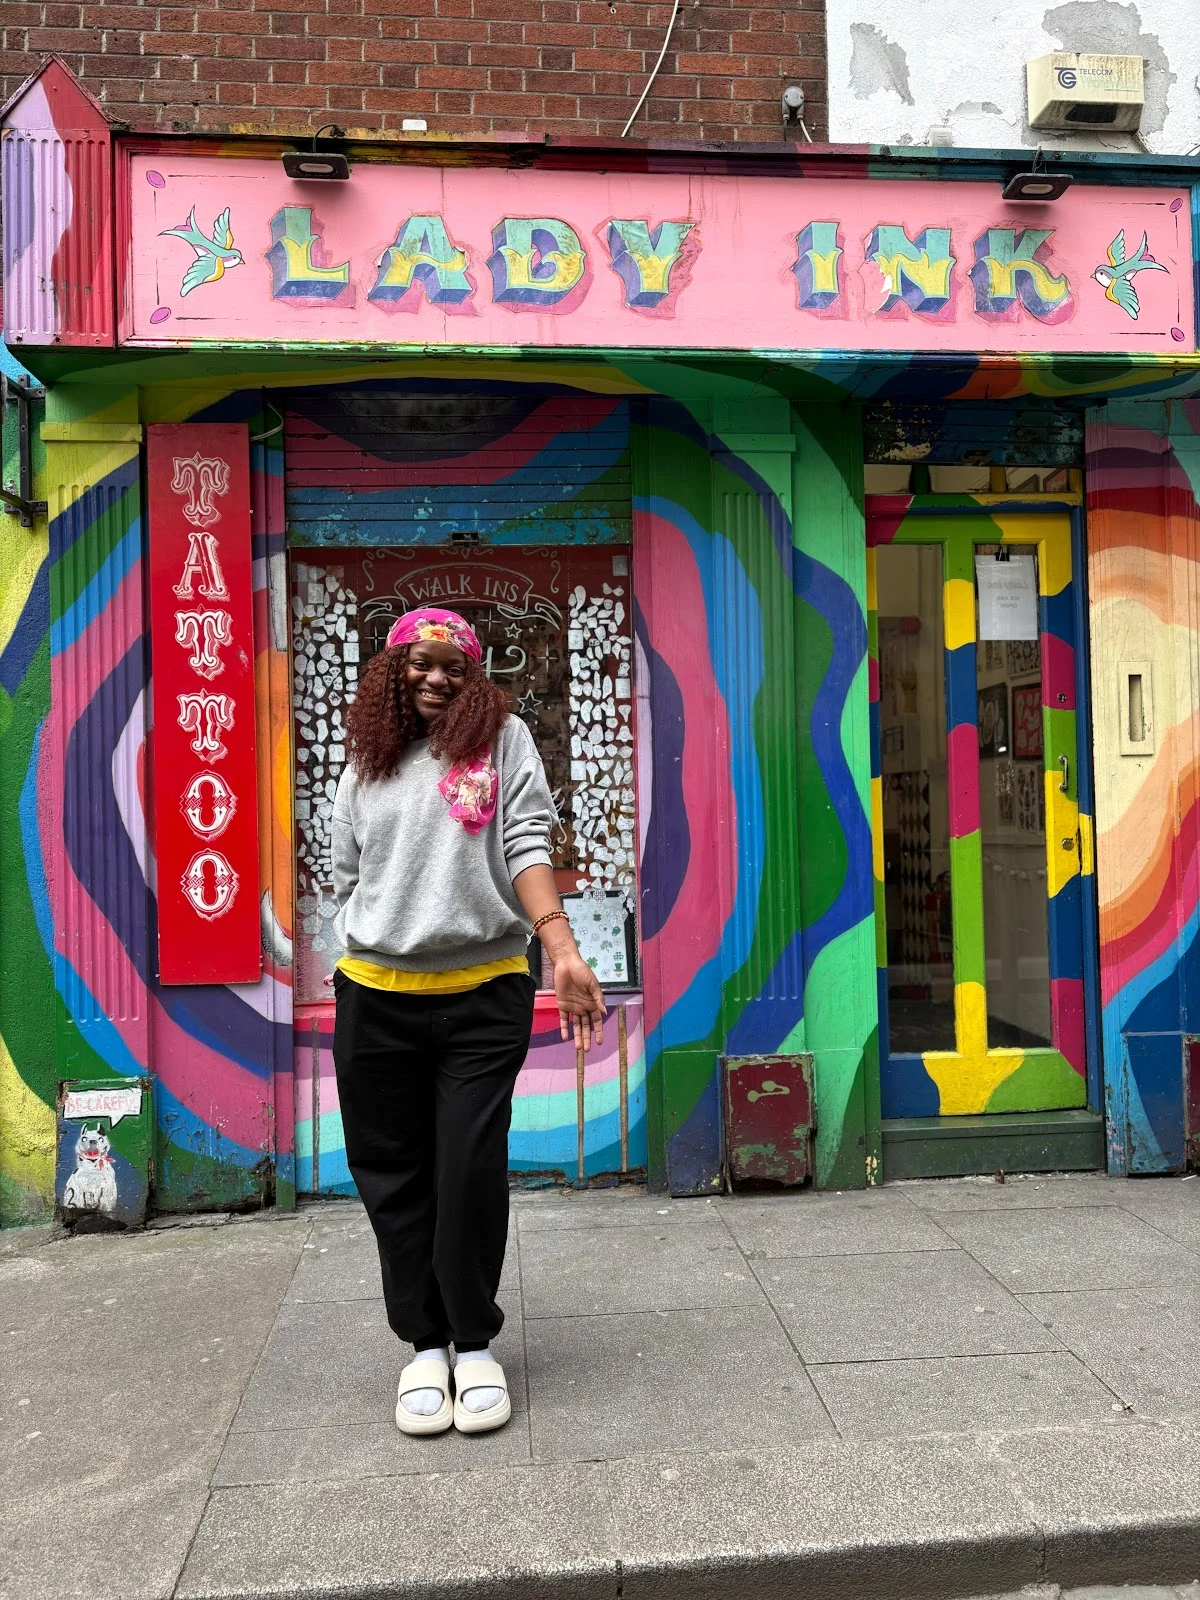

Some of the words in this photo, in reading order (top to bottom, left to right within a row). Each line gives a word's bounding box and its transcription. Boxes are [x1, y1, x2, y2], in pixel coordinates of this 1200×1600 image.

[1079, 67, 1113, 76] TELECOM
[264, 206, 700, 318] LADY
[790, 221, 1074, 324] INK
[407, 574, 474, 601] WALK
[482, 576, 520, 603] INS
[171, 452, 241, 921] TATTOO
[66, 1097, 82, 1113] BE
